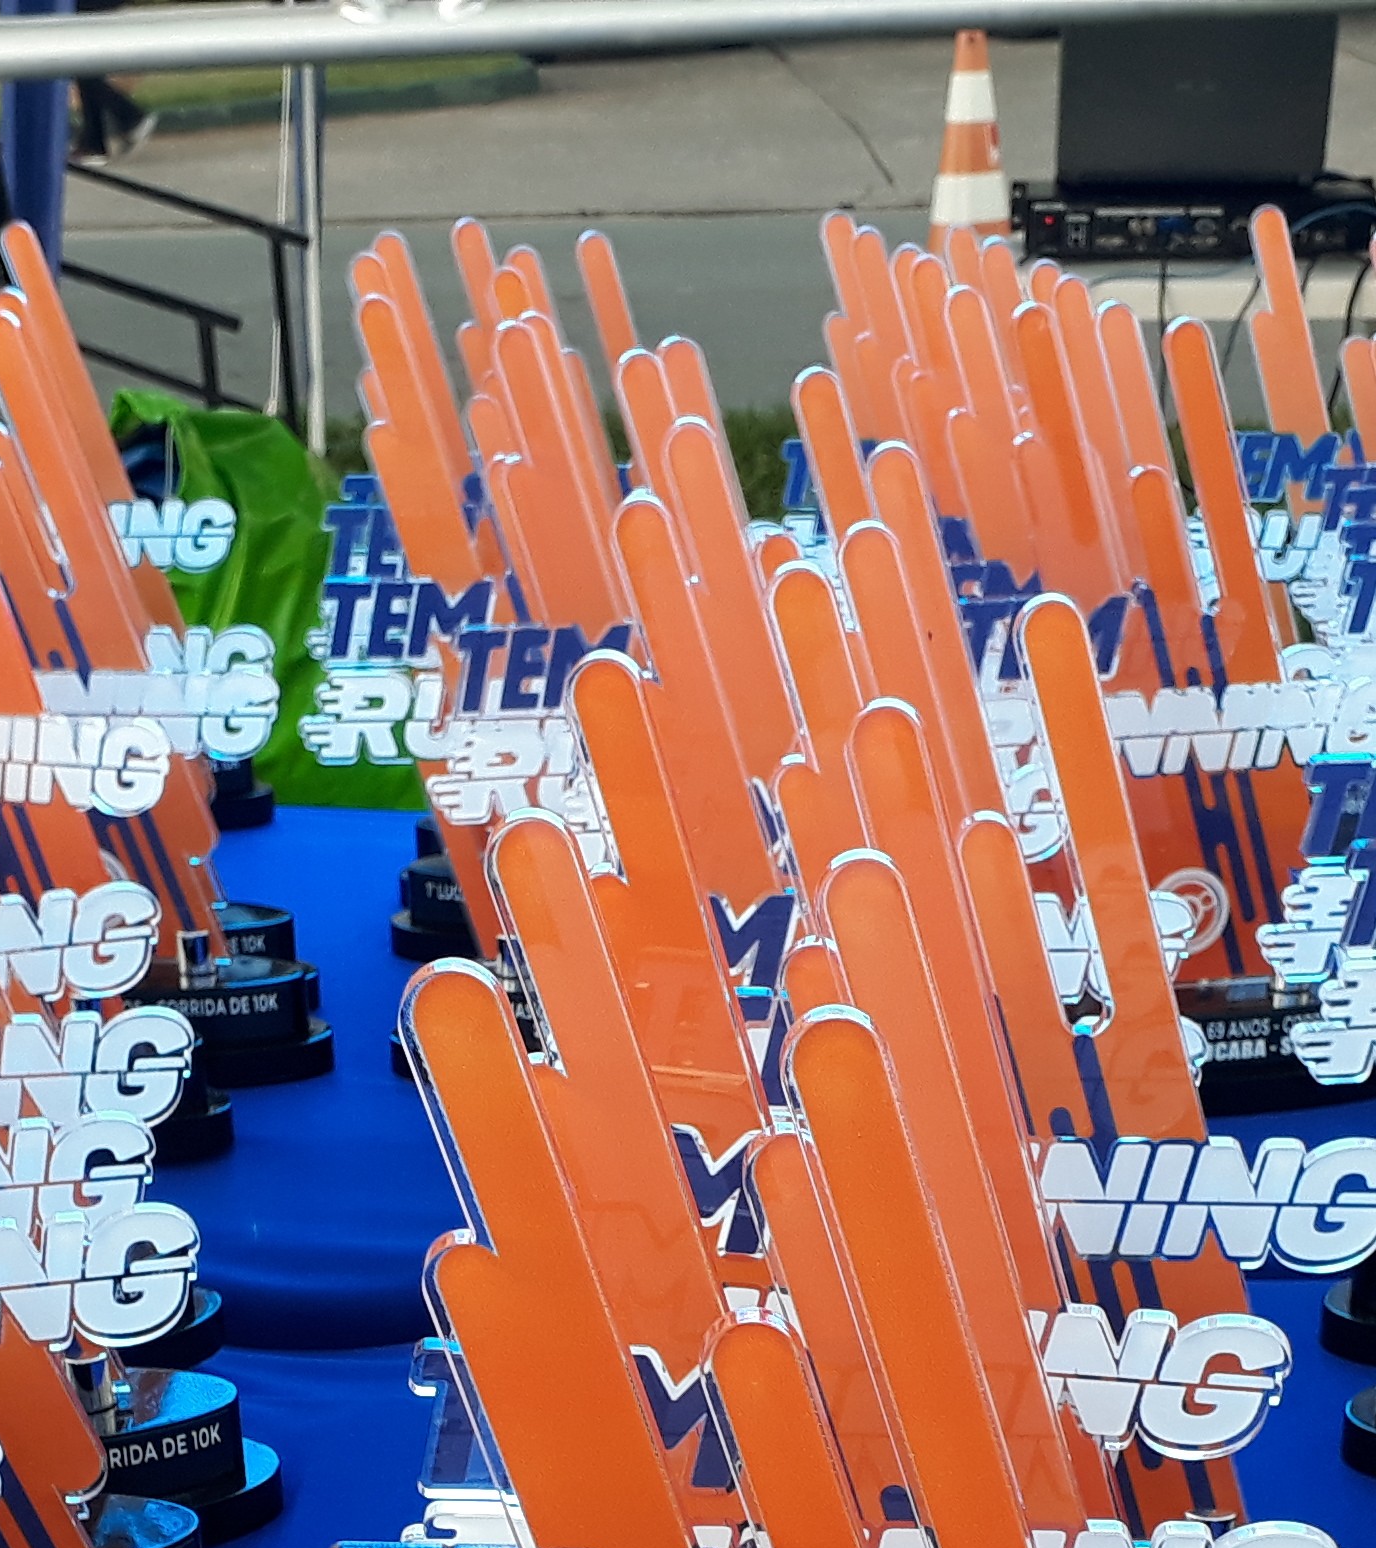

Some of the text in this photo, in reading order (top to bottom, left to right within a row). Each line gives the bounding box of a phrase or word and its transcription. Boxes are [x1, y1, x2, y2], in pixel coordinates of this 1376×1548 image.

[325, 579, 494, 660] TEM
[109, 1422, 222, 1470] RIDA DE 10K
